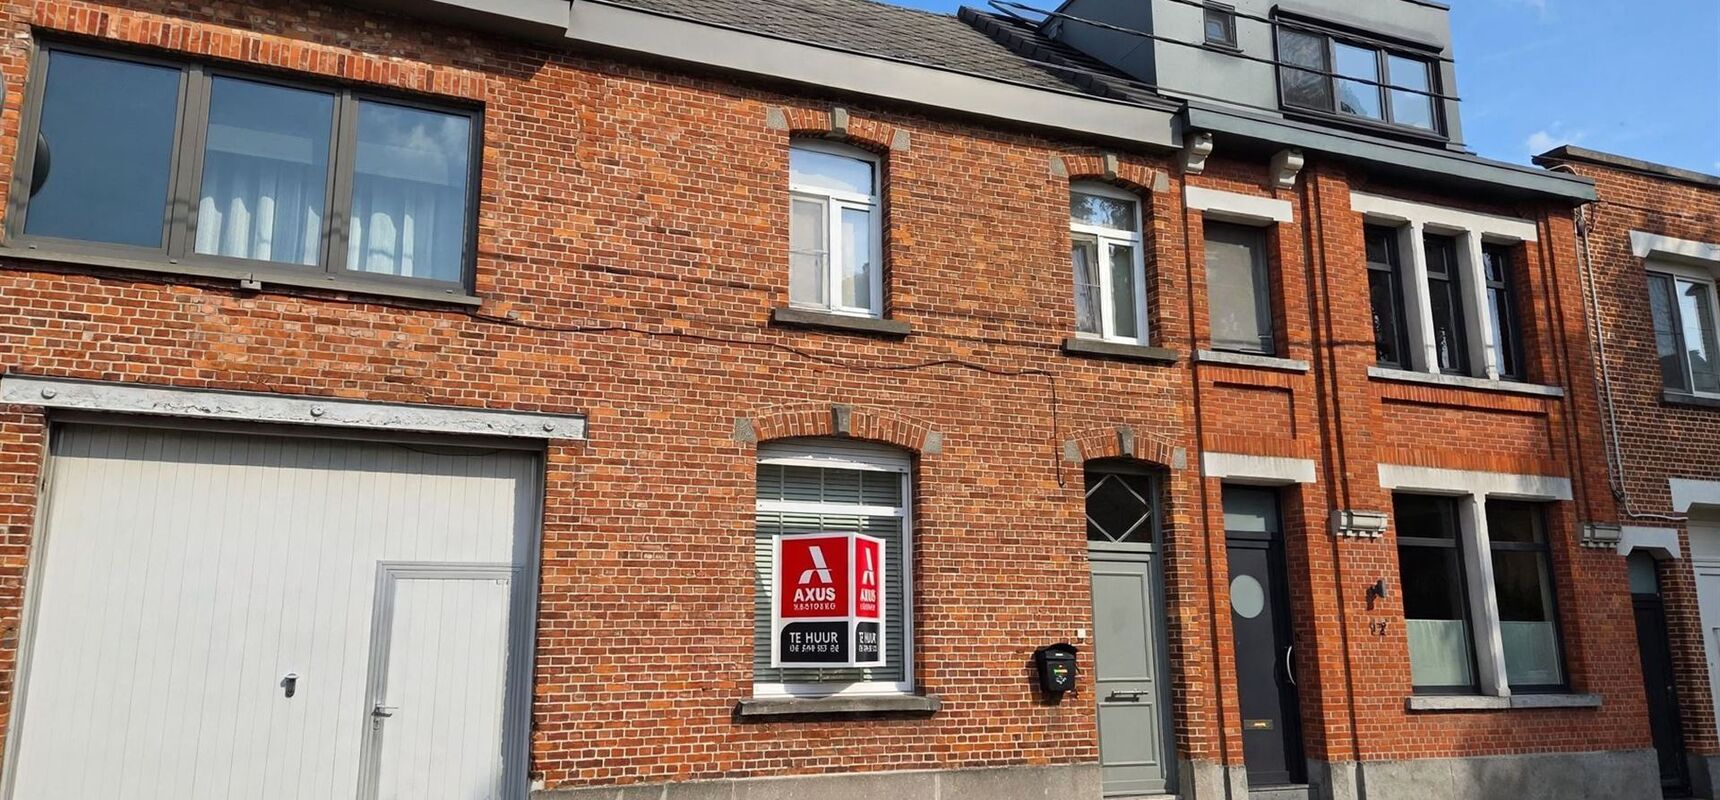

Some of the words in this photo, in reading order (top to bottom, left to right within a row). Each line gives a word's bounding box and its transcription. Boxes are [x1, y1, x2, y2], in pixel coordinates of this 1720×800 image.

[794, 587, 836, 602] AXUS
[789, 632, 801, 643] TE
[805, 632, 838, 643] HUUR
